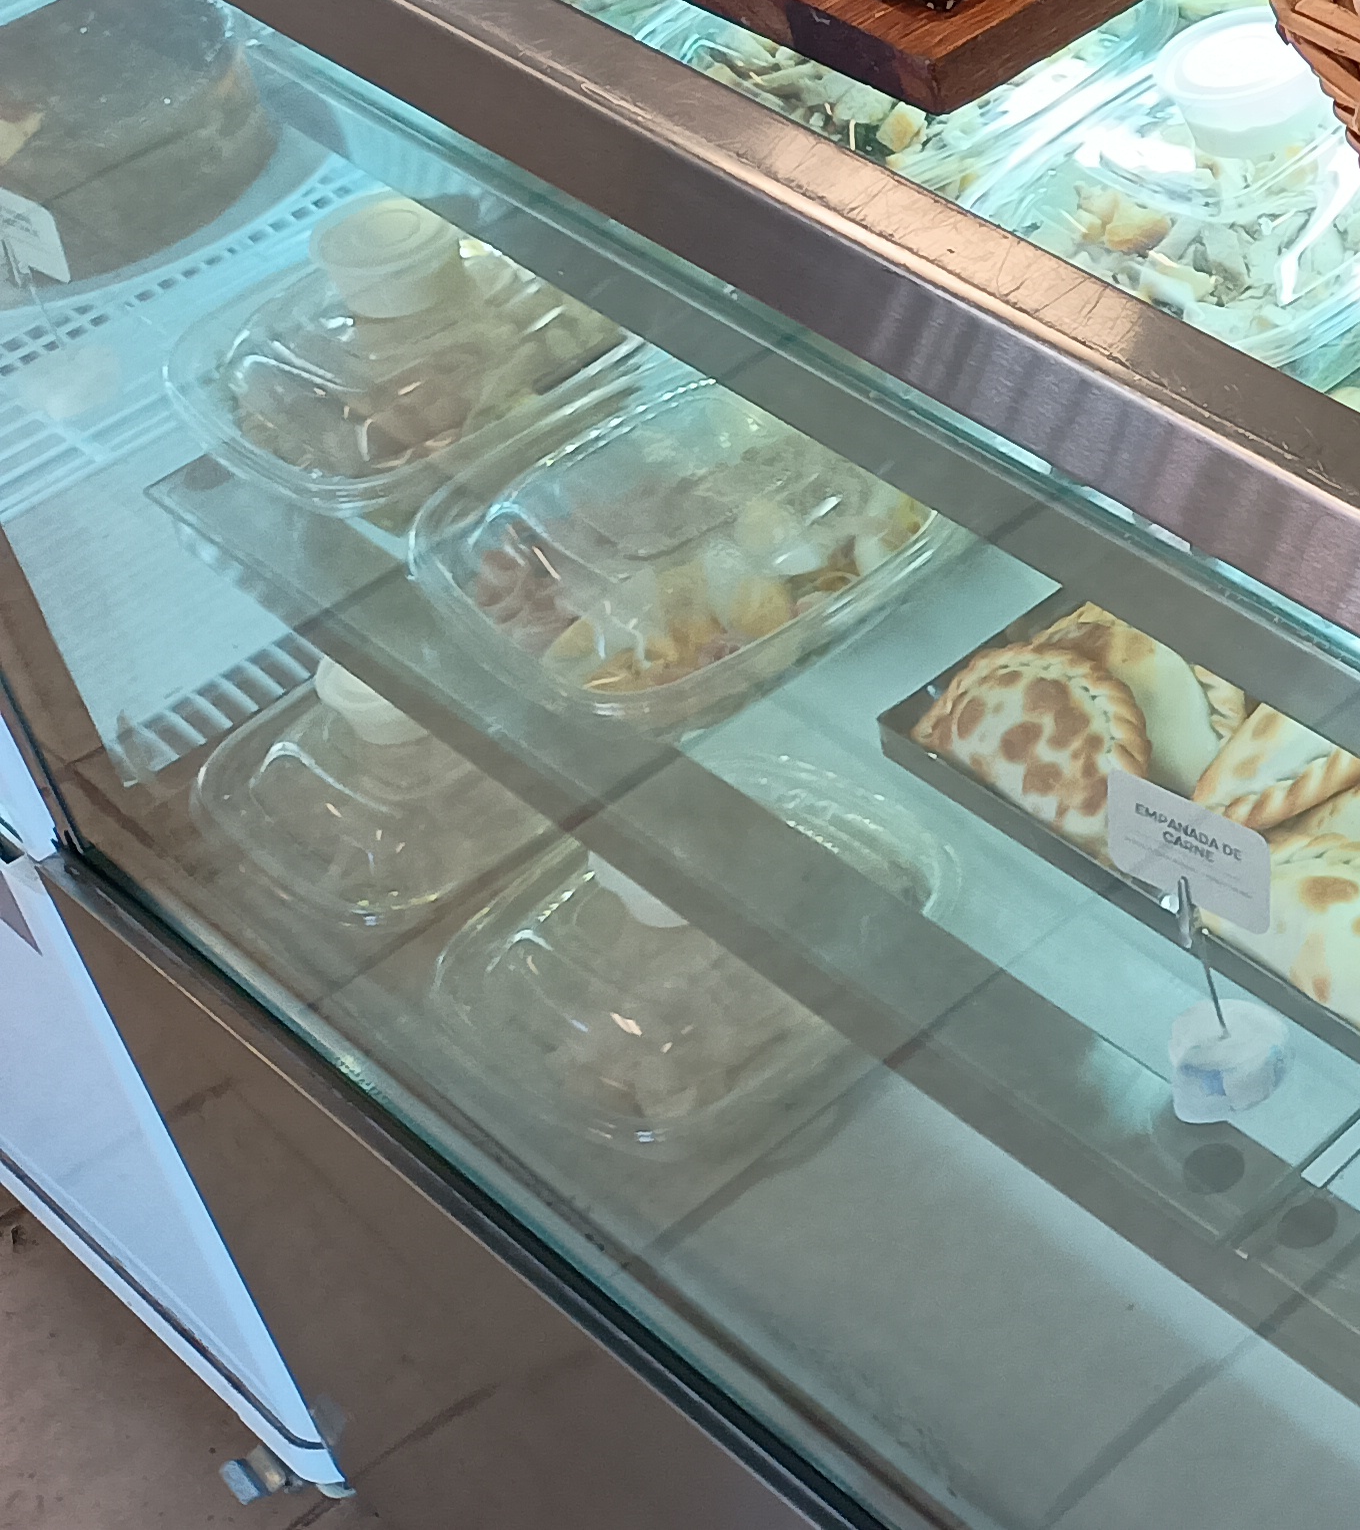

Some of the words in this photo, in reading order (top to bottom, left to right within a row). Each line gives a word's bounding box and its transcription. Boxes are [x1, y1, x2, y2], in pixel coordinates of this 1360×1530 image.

[1134, 802, 1219, 851] EMPANADA
[1221, 842, 1242, 862] DE
[1162, 830, 1215, 863] CARNE
